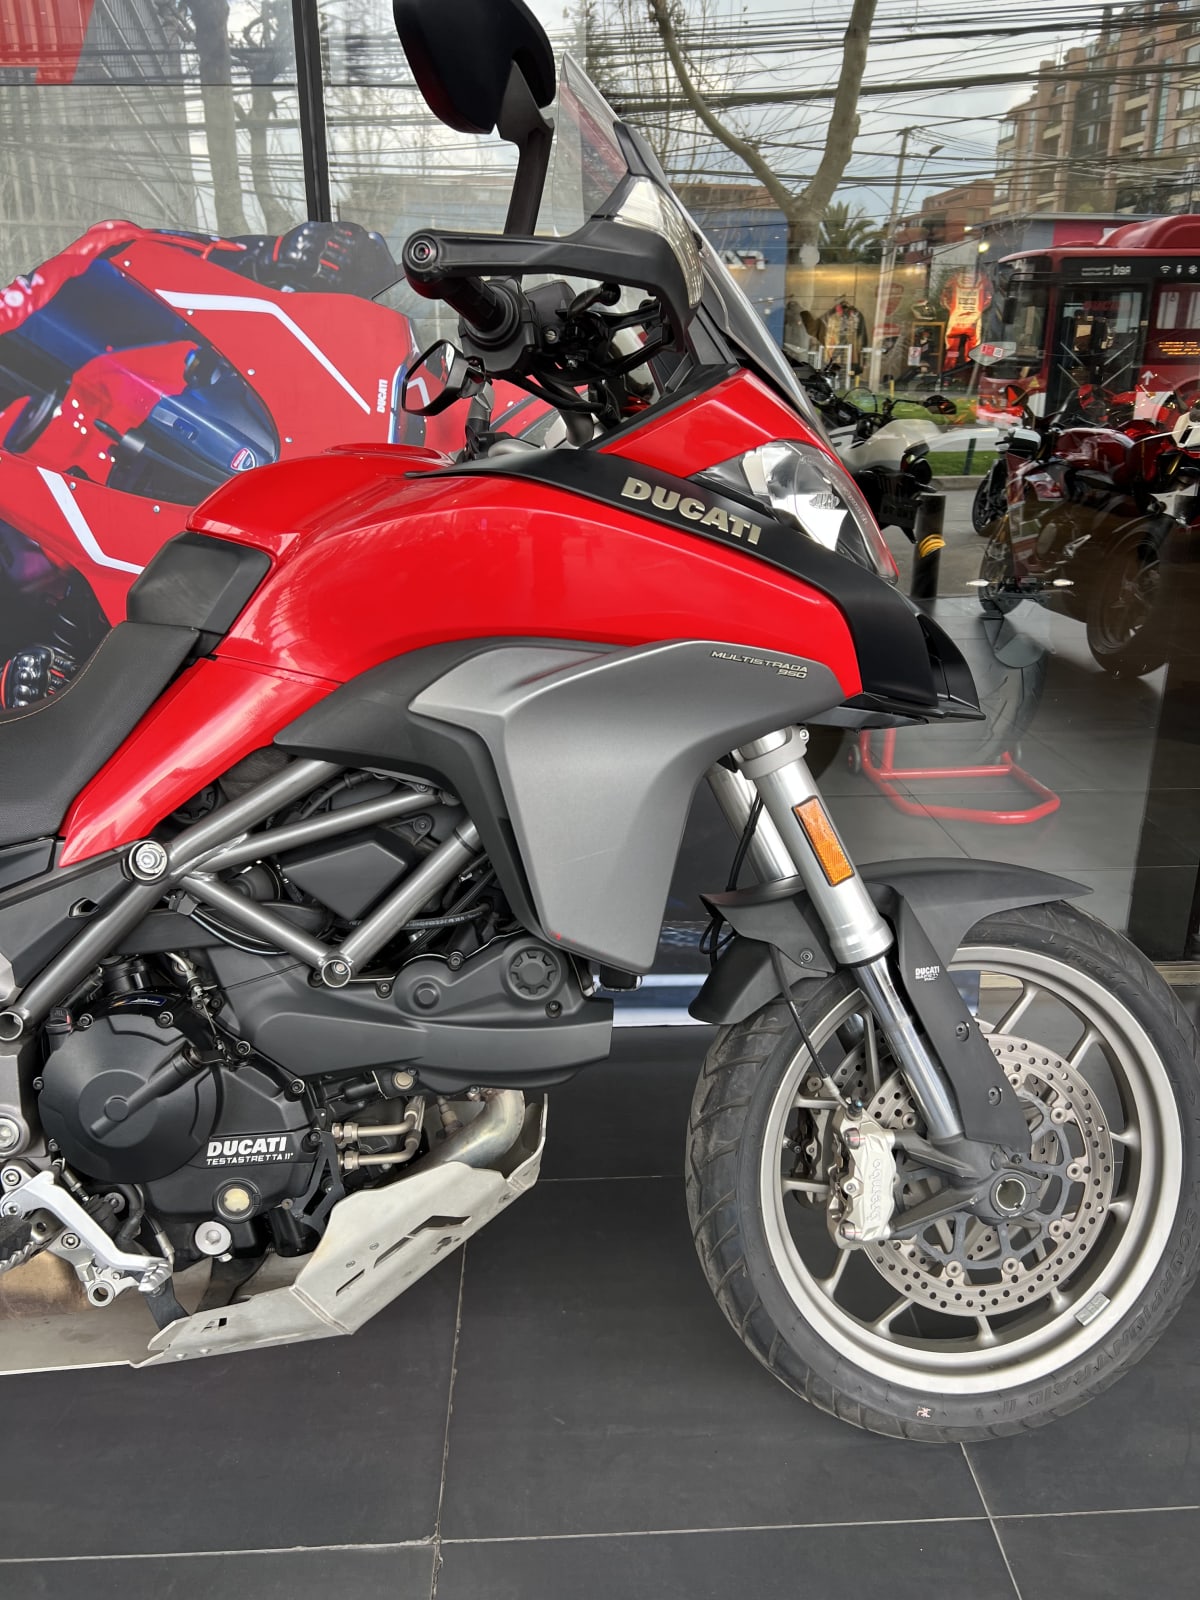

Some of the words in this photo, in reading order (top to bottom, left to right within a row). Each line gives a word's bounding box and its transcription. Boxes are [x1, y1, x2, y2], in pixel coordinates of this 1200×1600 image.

[376, 378, 388, 413] DUCATI
[620, 476, 762, 545] DUCATI
[711, 651, 808, 673] MULTISTRADA
[777, 668, 807, 679] 950
[915, 965, 940, 977] DUCATI
[206, 1136, 287, 1157] DUCATI
[206, 1154, 283, 1166] TESTASTRETTA
[866, 1158, 881, 1221] brembo
